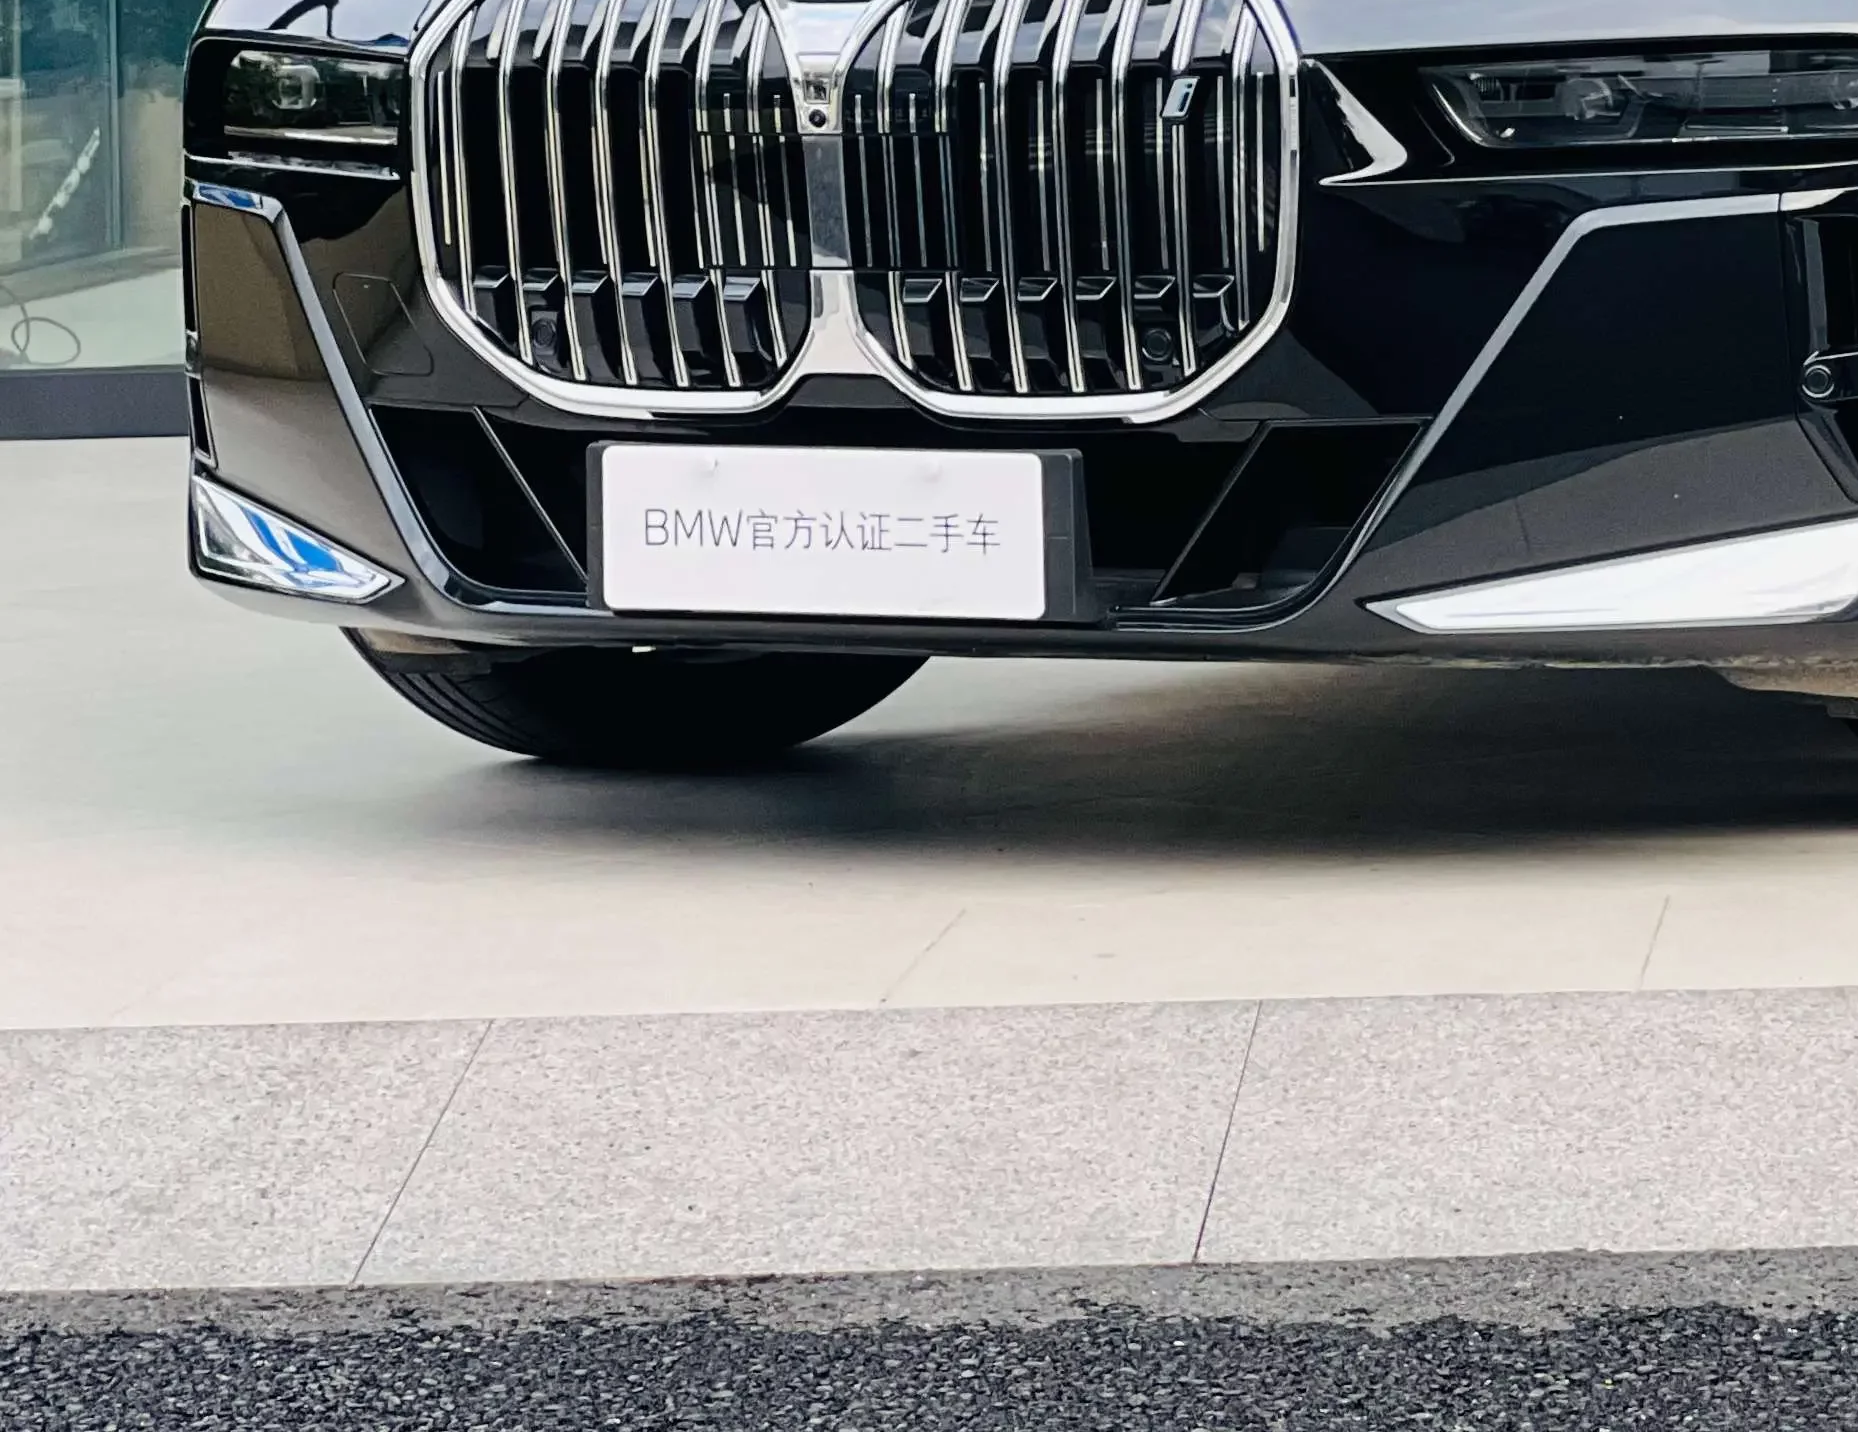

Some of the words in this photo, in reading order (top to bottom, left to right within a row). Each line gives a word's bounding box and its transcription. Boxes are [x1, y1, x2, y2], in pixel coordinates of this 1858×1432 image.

[644, 508, 1001, 556] BMW官方认证二手车
